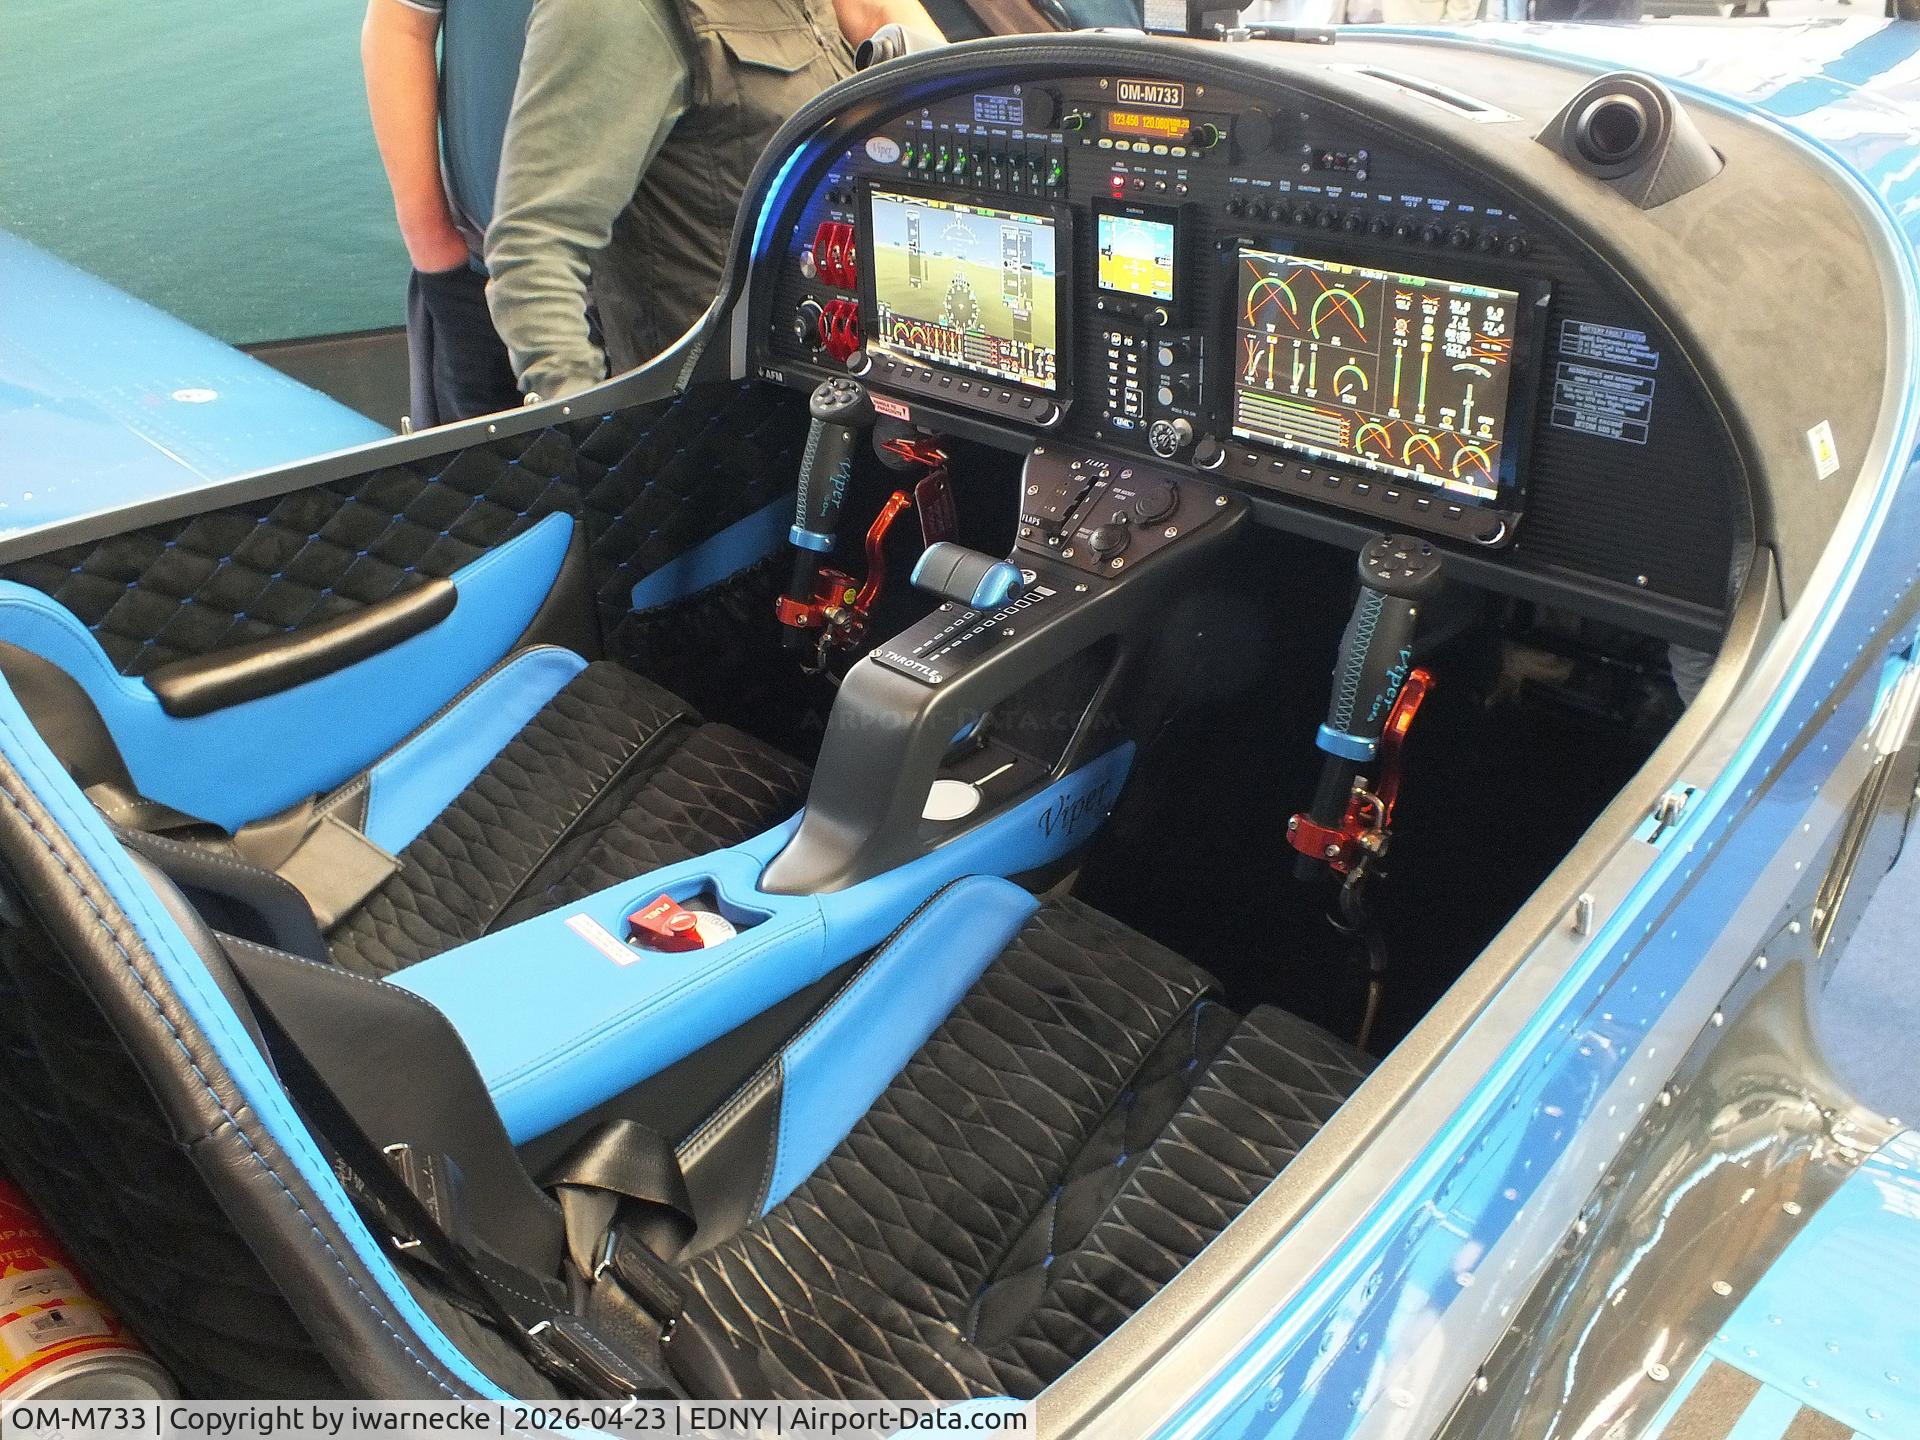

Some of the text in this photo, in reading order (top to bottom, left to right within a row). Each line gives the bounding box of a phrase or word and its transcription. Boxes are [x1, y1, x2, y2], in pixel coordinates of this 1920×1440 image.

[1119, 83, 1180, 104] OM-M733
[765, 369, 783, 382] AFM
[1085, 458, 1109, 470] FLAPS
[1021, 513, 1040, 526] FLAPS
[885, 651, 940, 678] THROTTLE
[1038, 778, 1111, 839] Viper
[643, 902, 671, 920] FUEL
